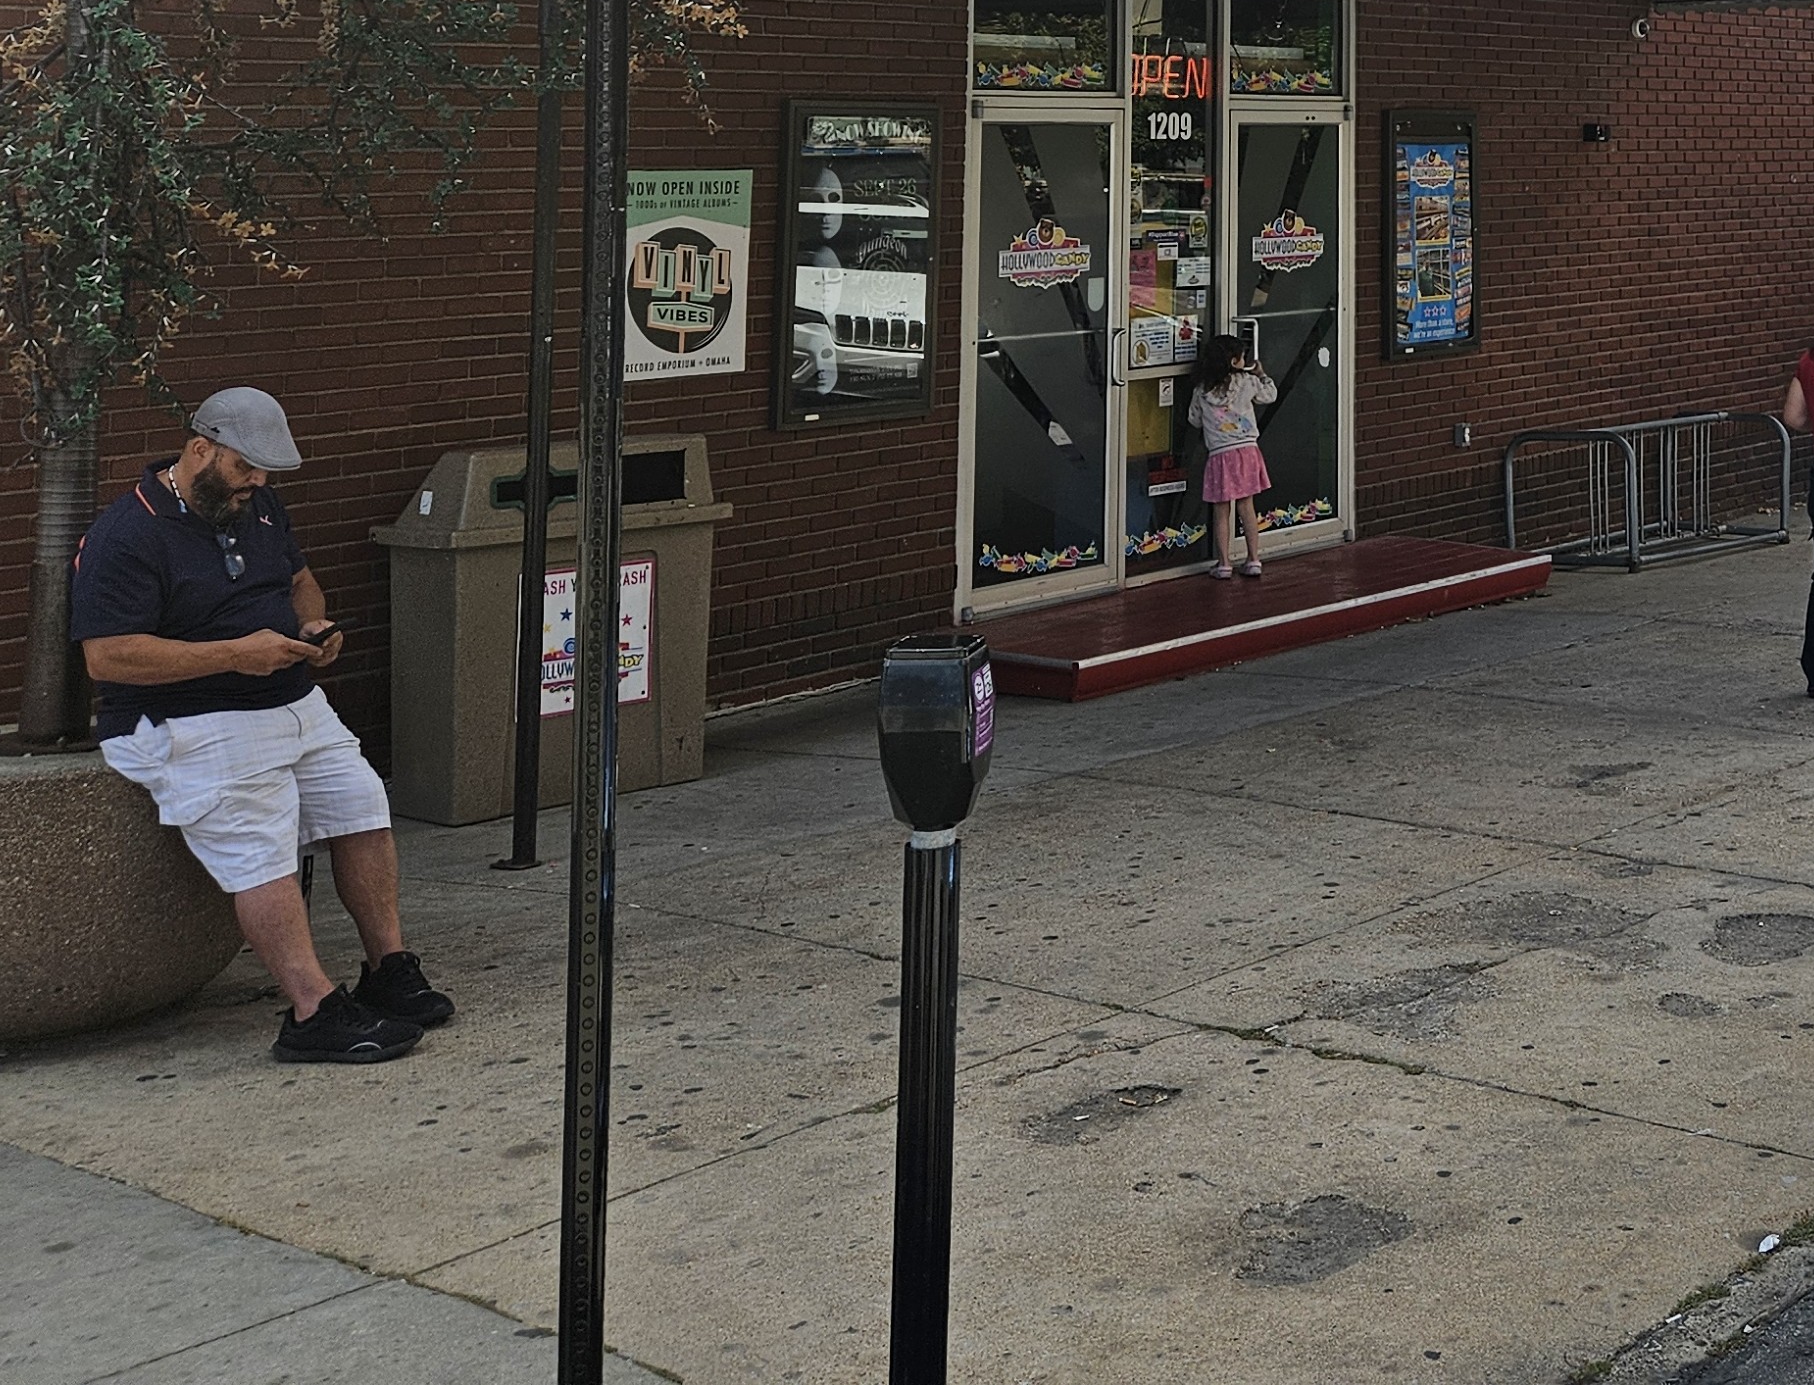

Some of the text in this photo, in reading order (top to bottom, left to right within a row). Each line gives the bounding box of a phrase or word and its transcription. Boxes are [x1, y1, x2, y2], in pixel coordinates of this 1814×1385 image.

[1147, 112, 1192, 140] 1209
[627, 180, 740, 196] NOW OPEN INSIDE
[670, 198, 700, 209] VINTAGE
[703, 197, 731, 208] ALBUMS
[643, 246, 725, 292] VINYL
[1001, 251, 1091, 271] HOLLYWOOD CANDY
[657, 307, 709, 323] VIBES
[625, 356, 731, 373] RECORD EMPORIUM OMAHA
[543, 579, 566, 596] ASH
[620, 569, 647, 587] ASH
